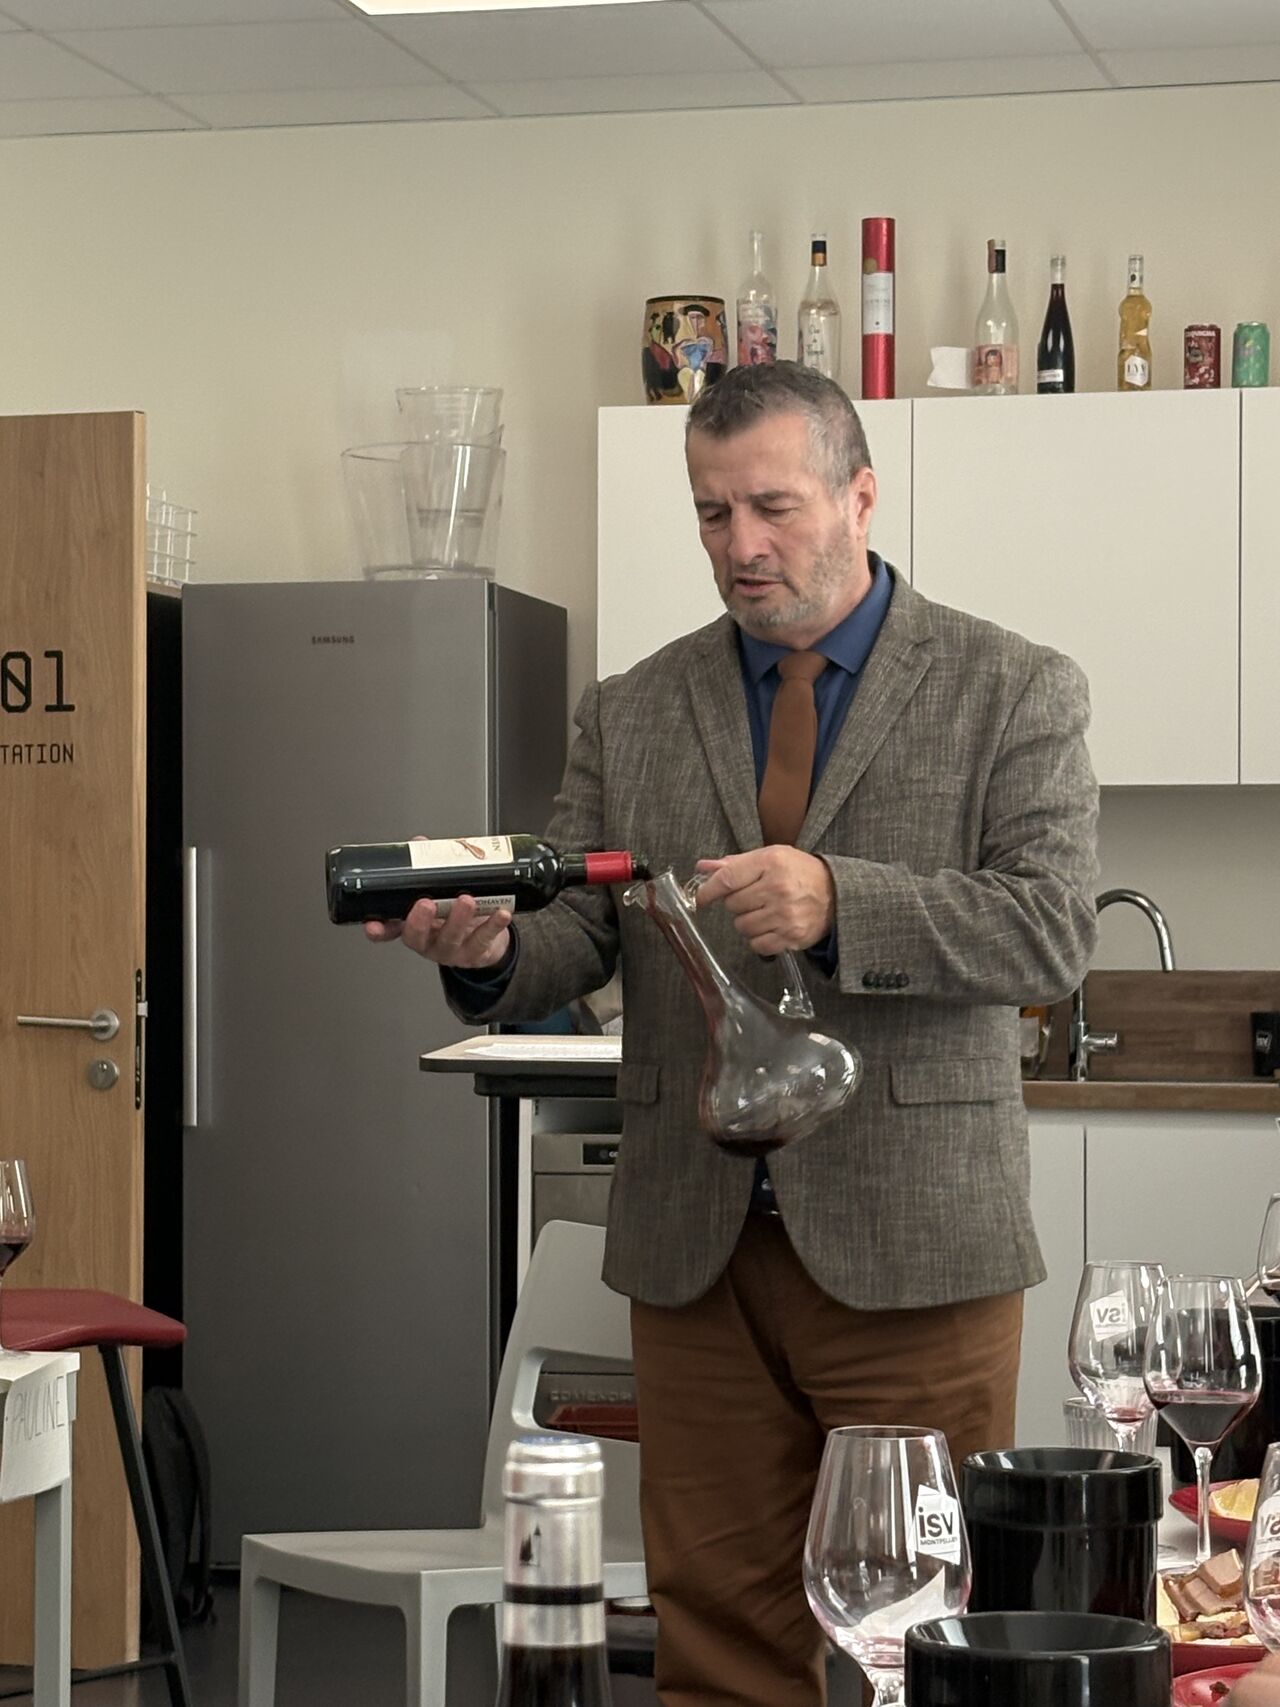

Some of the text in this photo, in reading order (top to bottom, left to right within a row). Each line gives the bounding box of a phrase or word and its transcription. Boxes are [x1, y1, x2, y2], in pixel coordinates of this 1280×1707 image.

[311, 635, 355, 645] SAMSUNG
[1, 650, 75, 713] 01
[0, 743, 74, 765] TATION
[12, 1375, 65, 1441] PAULINE
